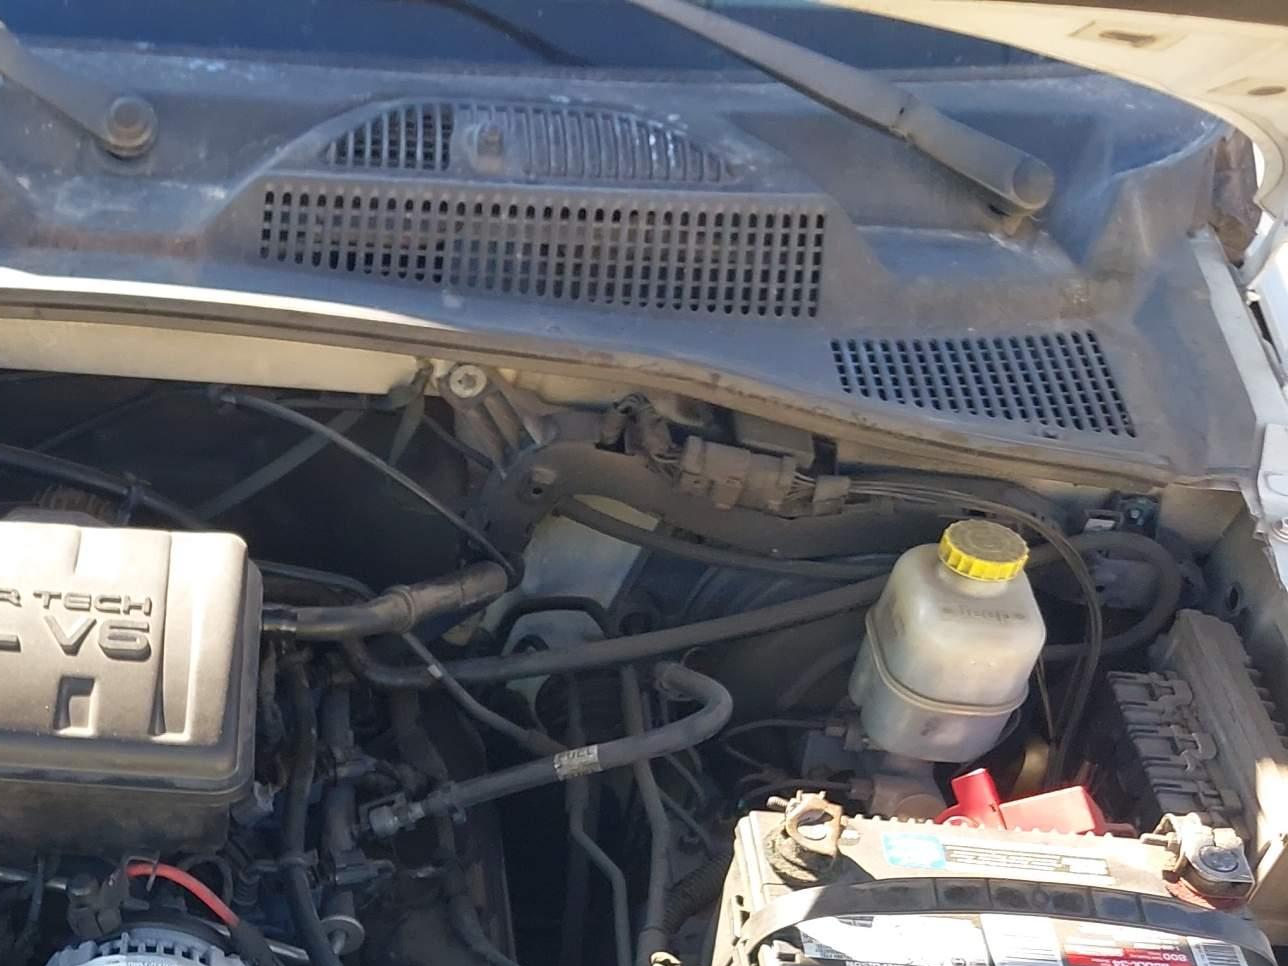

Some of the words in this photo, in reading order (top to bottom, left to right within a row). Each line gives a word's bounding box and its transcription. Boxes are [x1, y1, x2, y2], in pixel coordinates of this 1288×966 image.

[33, 590, 152, 617] TECH
[45, 614, 152, 662] V6
[1163, 951, 1187, 962] 800
